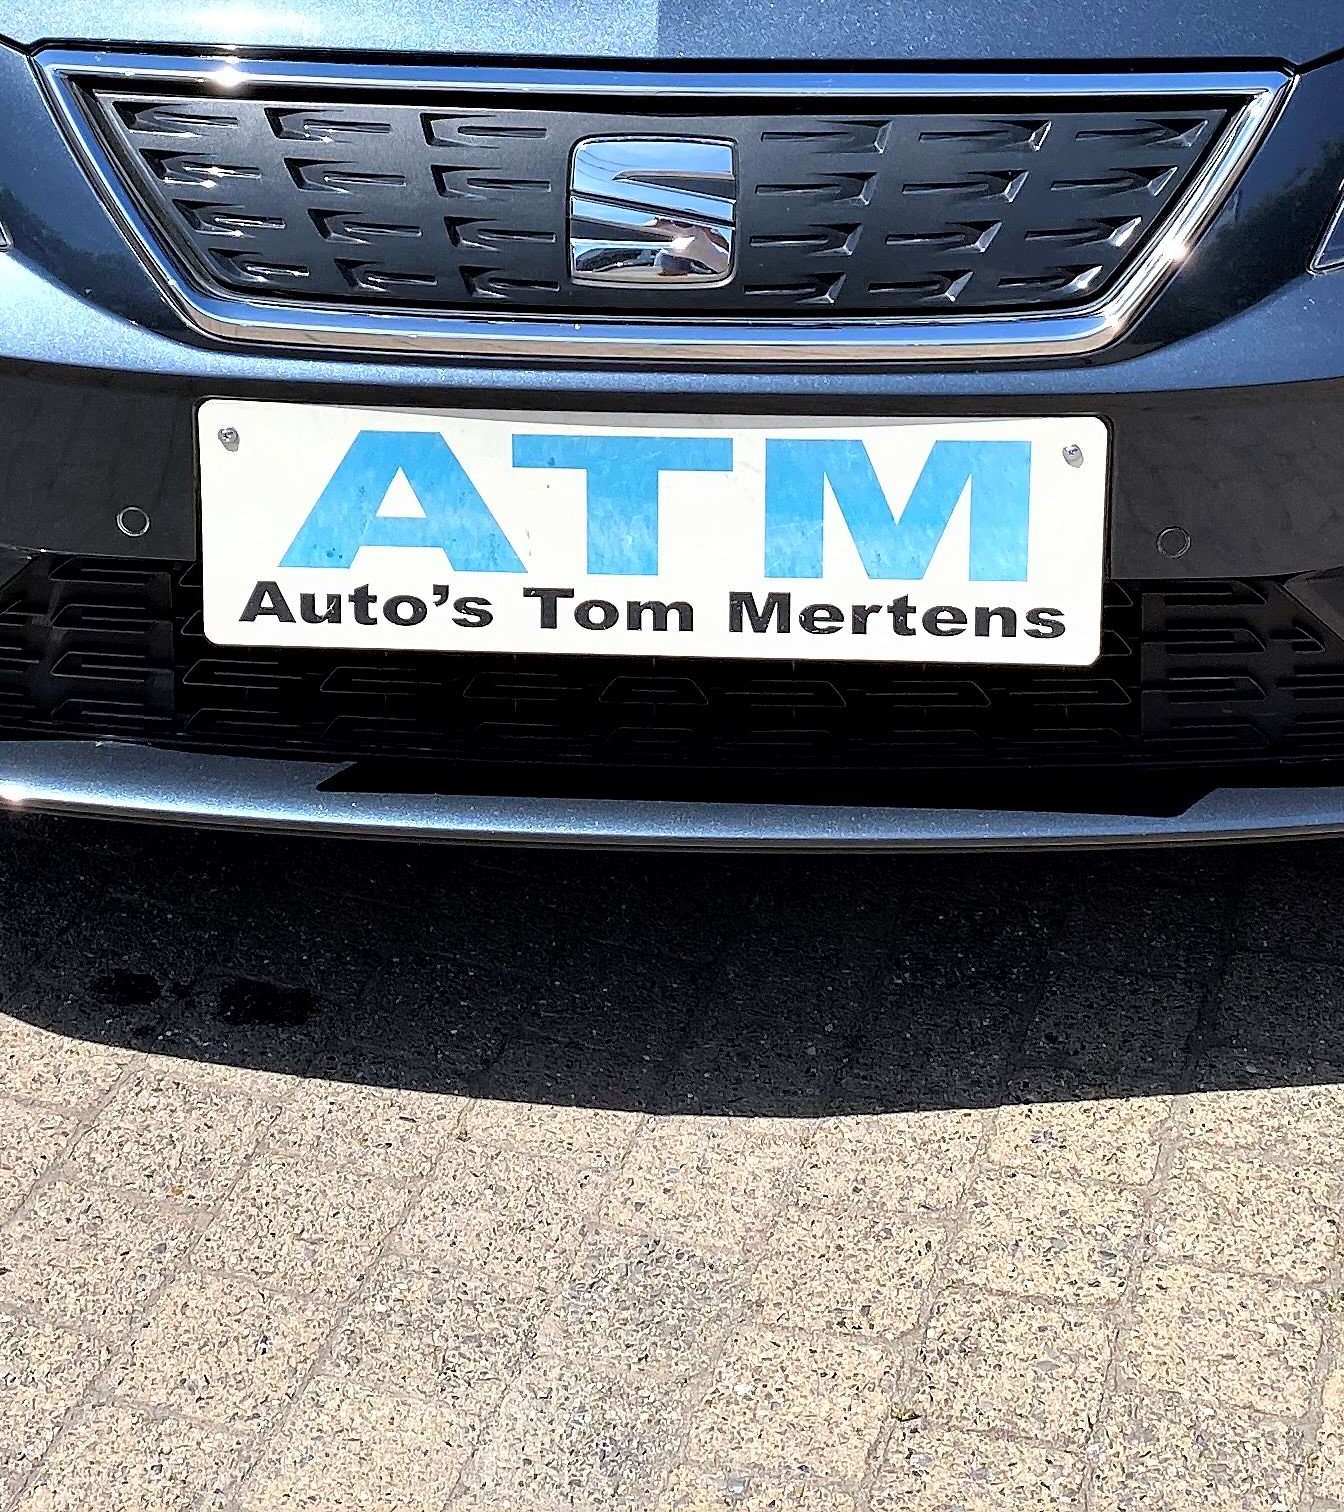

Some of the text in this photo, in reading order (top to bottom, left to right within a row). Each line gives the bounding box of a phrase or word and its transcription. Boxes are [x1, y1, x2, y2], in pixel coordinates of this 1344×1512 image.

[278, 430, 1032, 582] ATM
[522, 587, 695, 632] Tom
[728, 591, 1067, 639] Mertens
